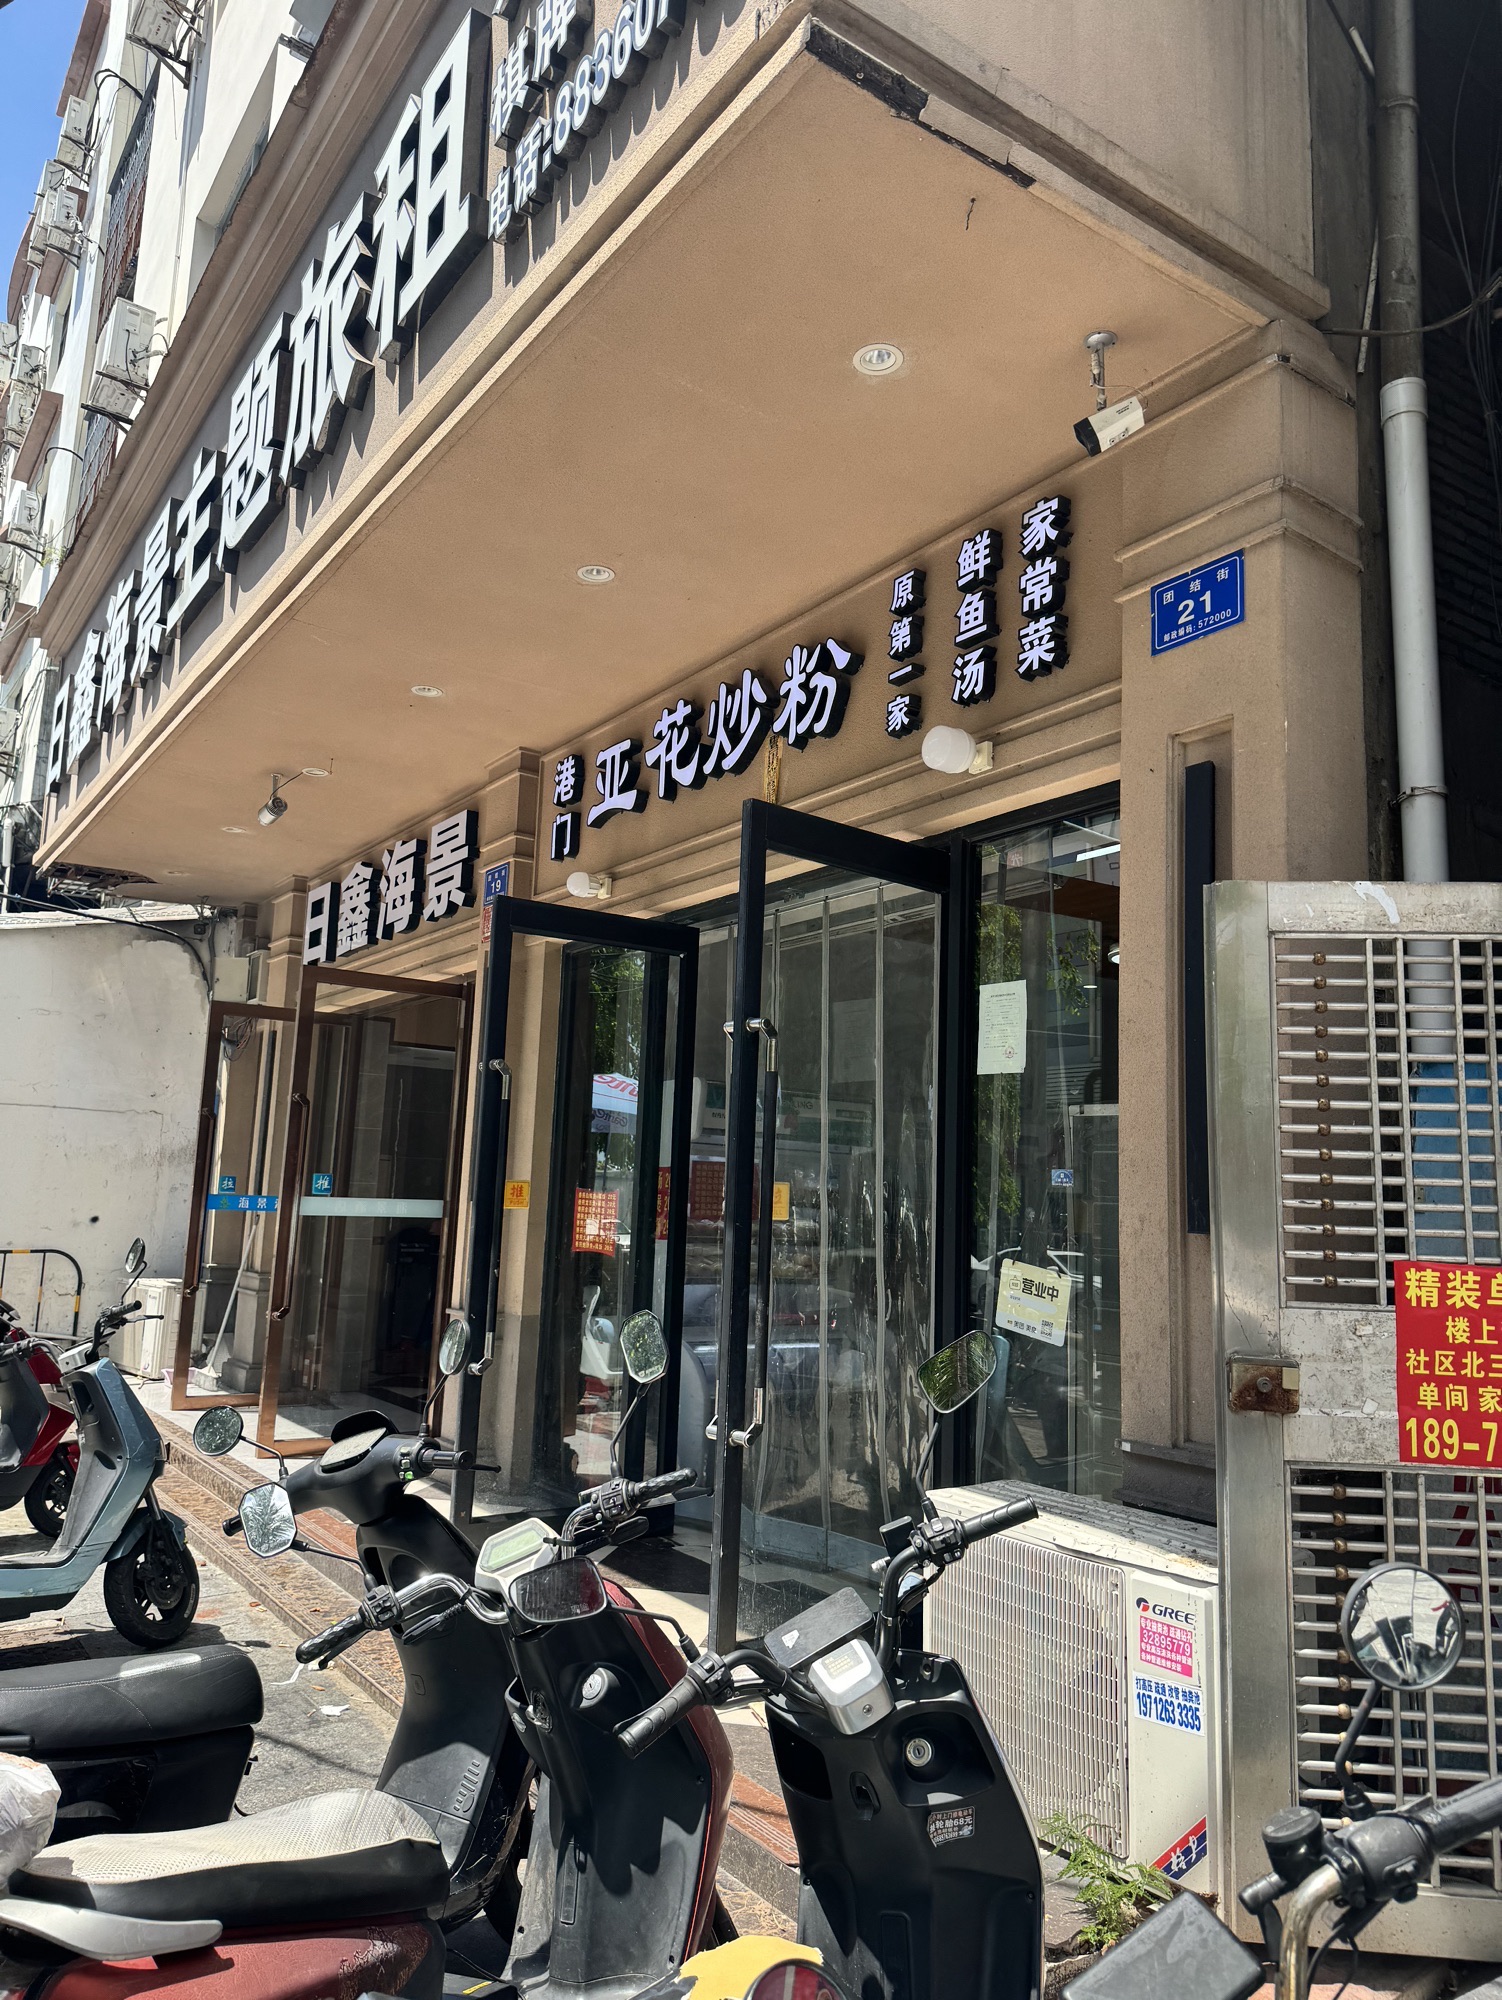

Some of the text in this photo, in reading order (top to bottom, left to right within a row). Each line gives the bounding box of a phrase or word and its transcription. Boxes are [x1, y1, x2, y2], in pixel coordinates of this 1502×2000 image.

[46, 22, 473, 794] 日鑫海景主题旅租
[1017, 496, 1061, 680] 家常菜
[1162, 566, 1230, 606] 团结街
[951, 530, 993, 706] 鲜鱼汤
[1177, 590, 1212, 625] 21
[886, 569, 917, 736] 原第一家
[586, 637, 853, 828] 亚花炒粉
[551, 755, 578, 860] 港门
[302, 810, 471, 966] 日鑫海景
[490, 879, 502, 895] 19
[221, 1177, 235, 1190] 拉
[315, 1175, 331, 1191] 推
[509, 1184, 525, 1198] 推
[1021, 1277, 1060, 1302] 营业中
[1417, 1382, 1470, 1412] 单间
[1152, 1604, 1196, 1625] GREE
[1142, 1629, 1191, 1657] 32895779
[1135, 1676, 1201, 1706] 打高压 疏通 改管 抽粪池
